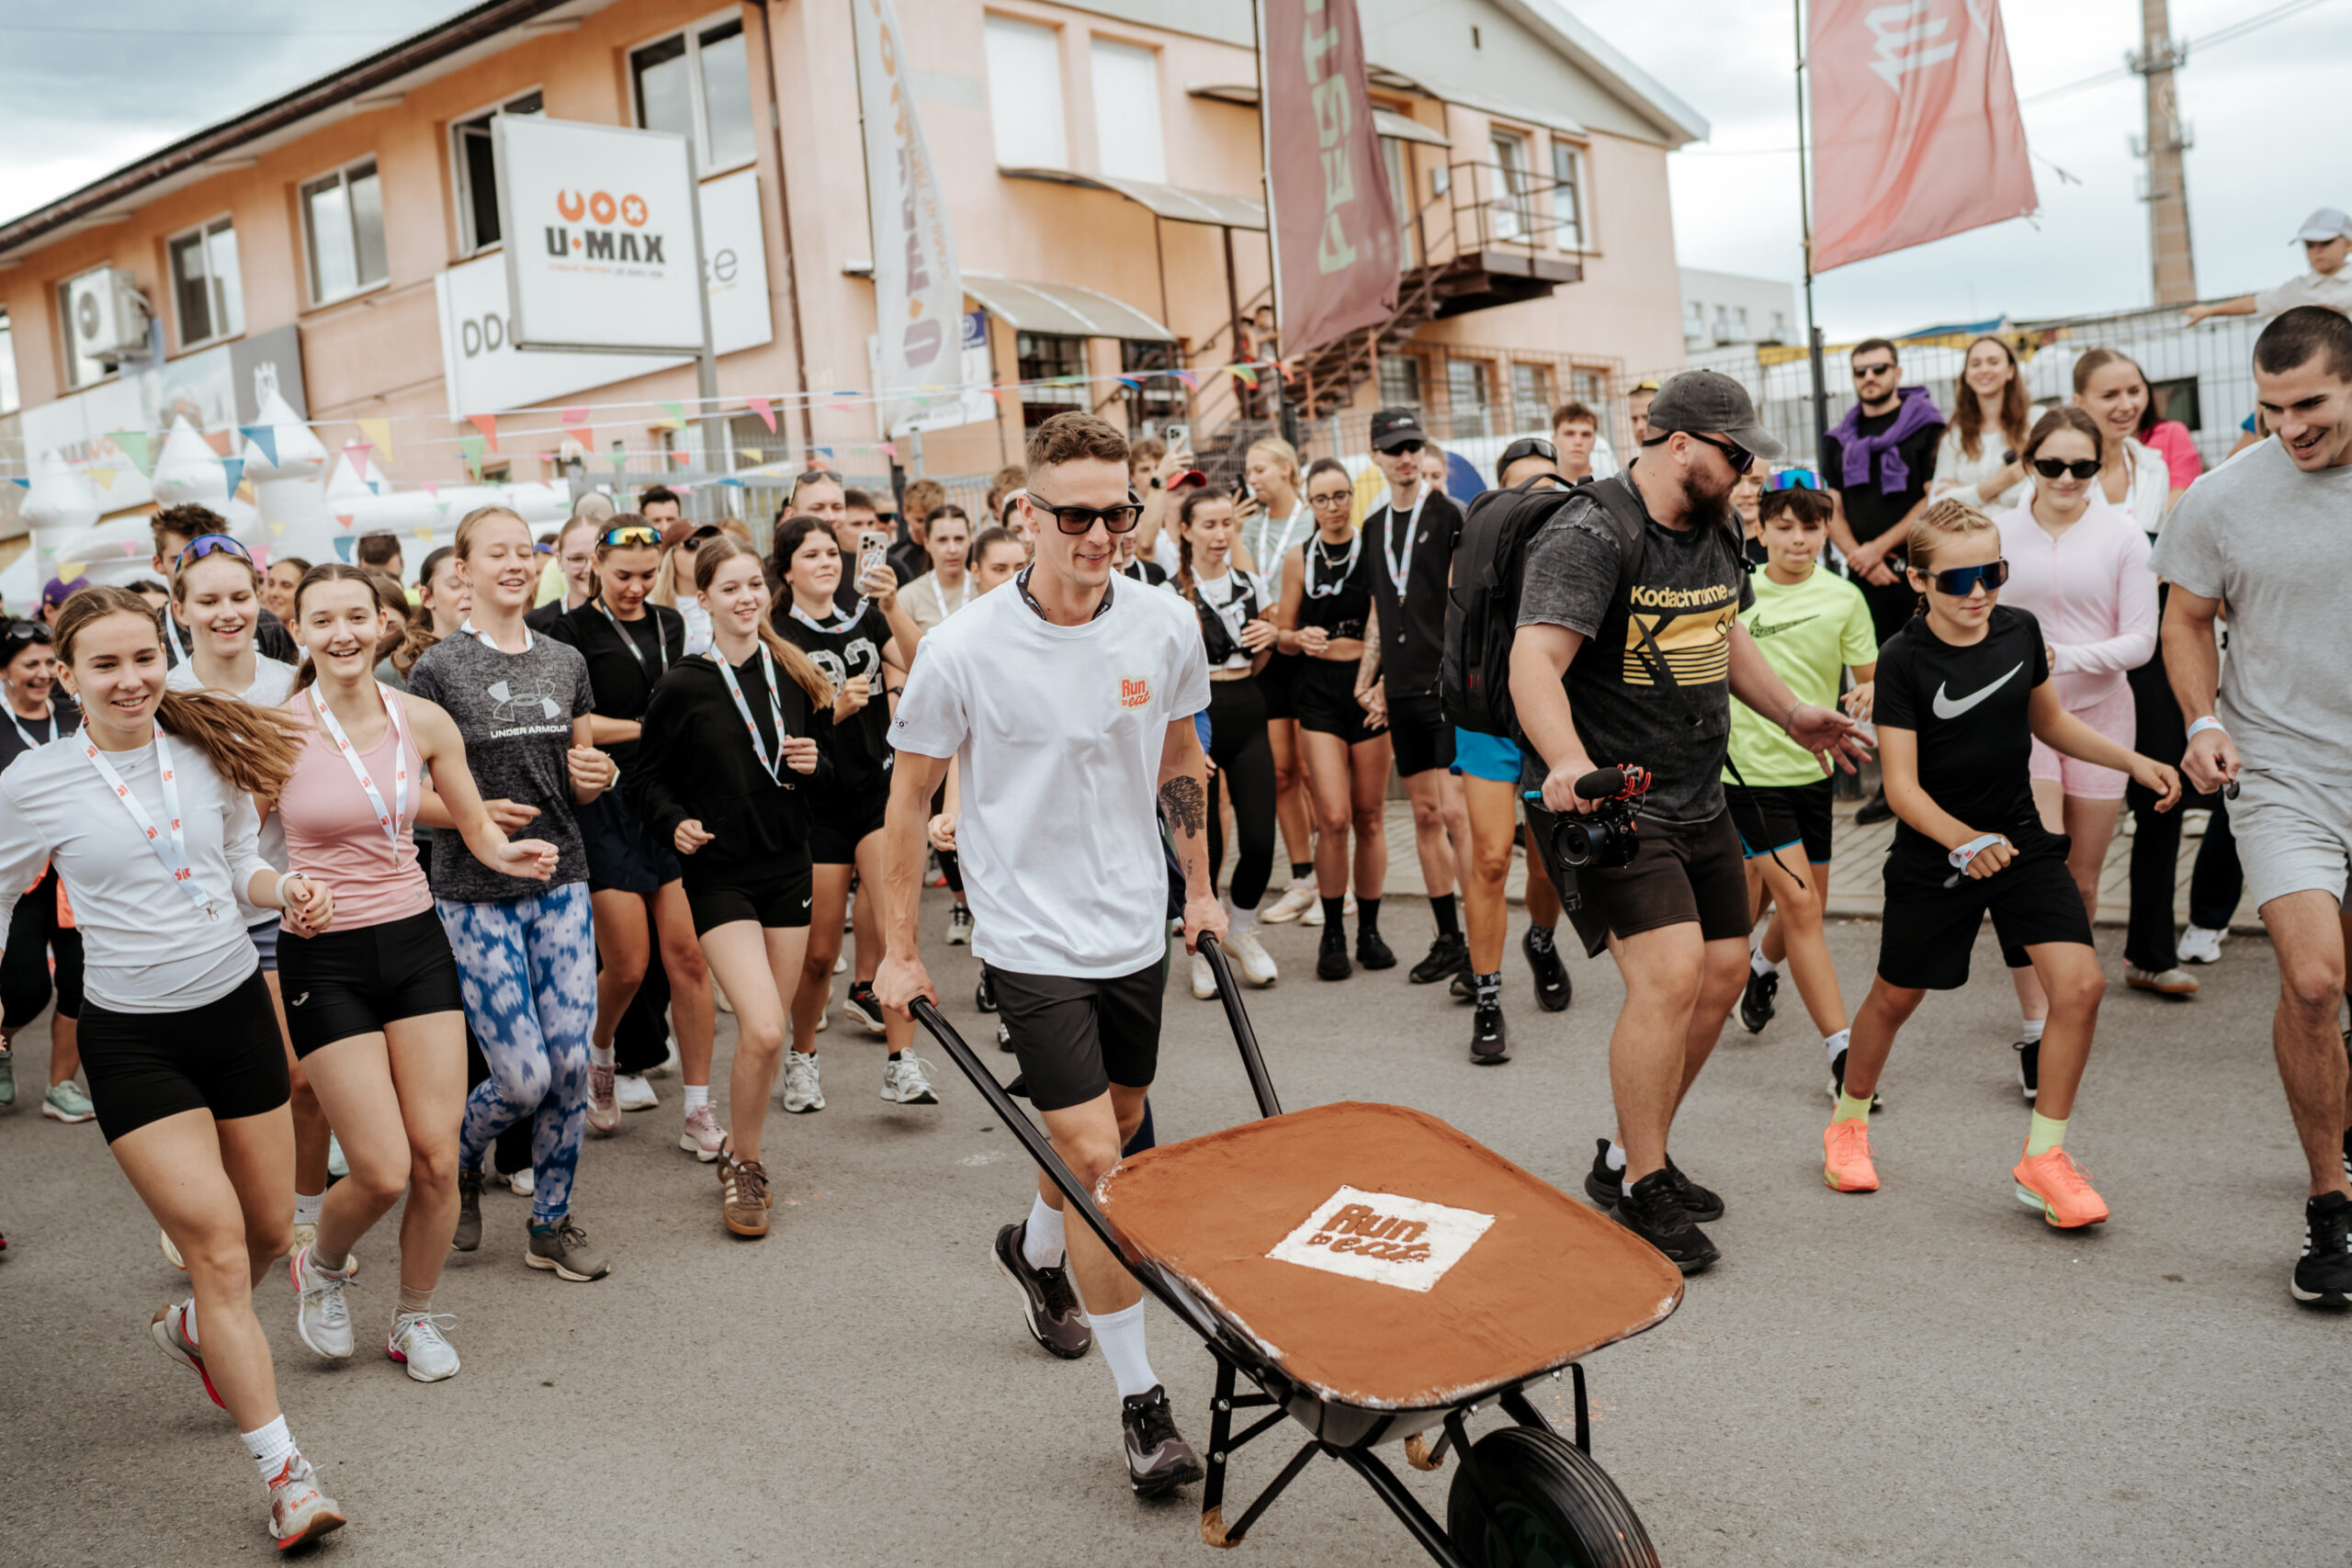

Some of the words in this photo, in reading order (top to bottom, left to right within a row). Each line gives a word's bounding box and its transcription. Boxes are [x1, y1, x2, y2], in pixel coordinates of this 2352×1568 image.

[1302, 0, 1357, 276] FEST
[1630, 583, 1728, 608] Kodachrome
[1122, 679, 1146, 697] Run
[1128, 690, 1150, 707] eat
[490, 727, 527, 739] UNDER
[528, 724, 568, 735] ARMOUR
[1320, 1203, 1428, 1243] Run
[1329, 1236, 1431, 1264] eat
